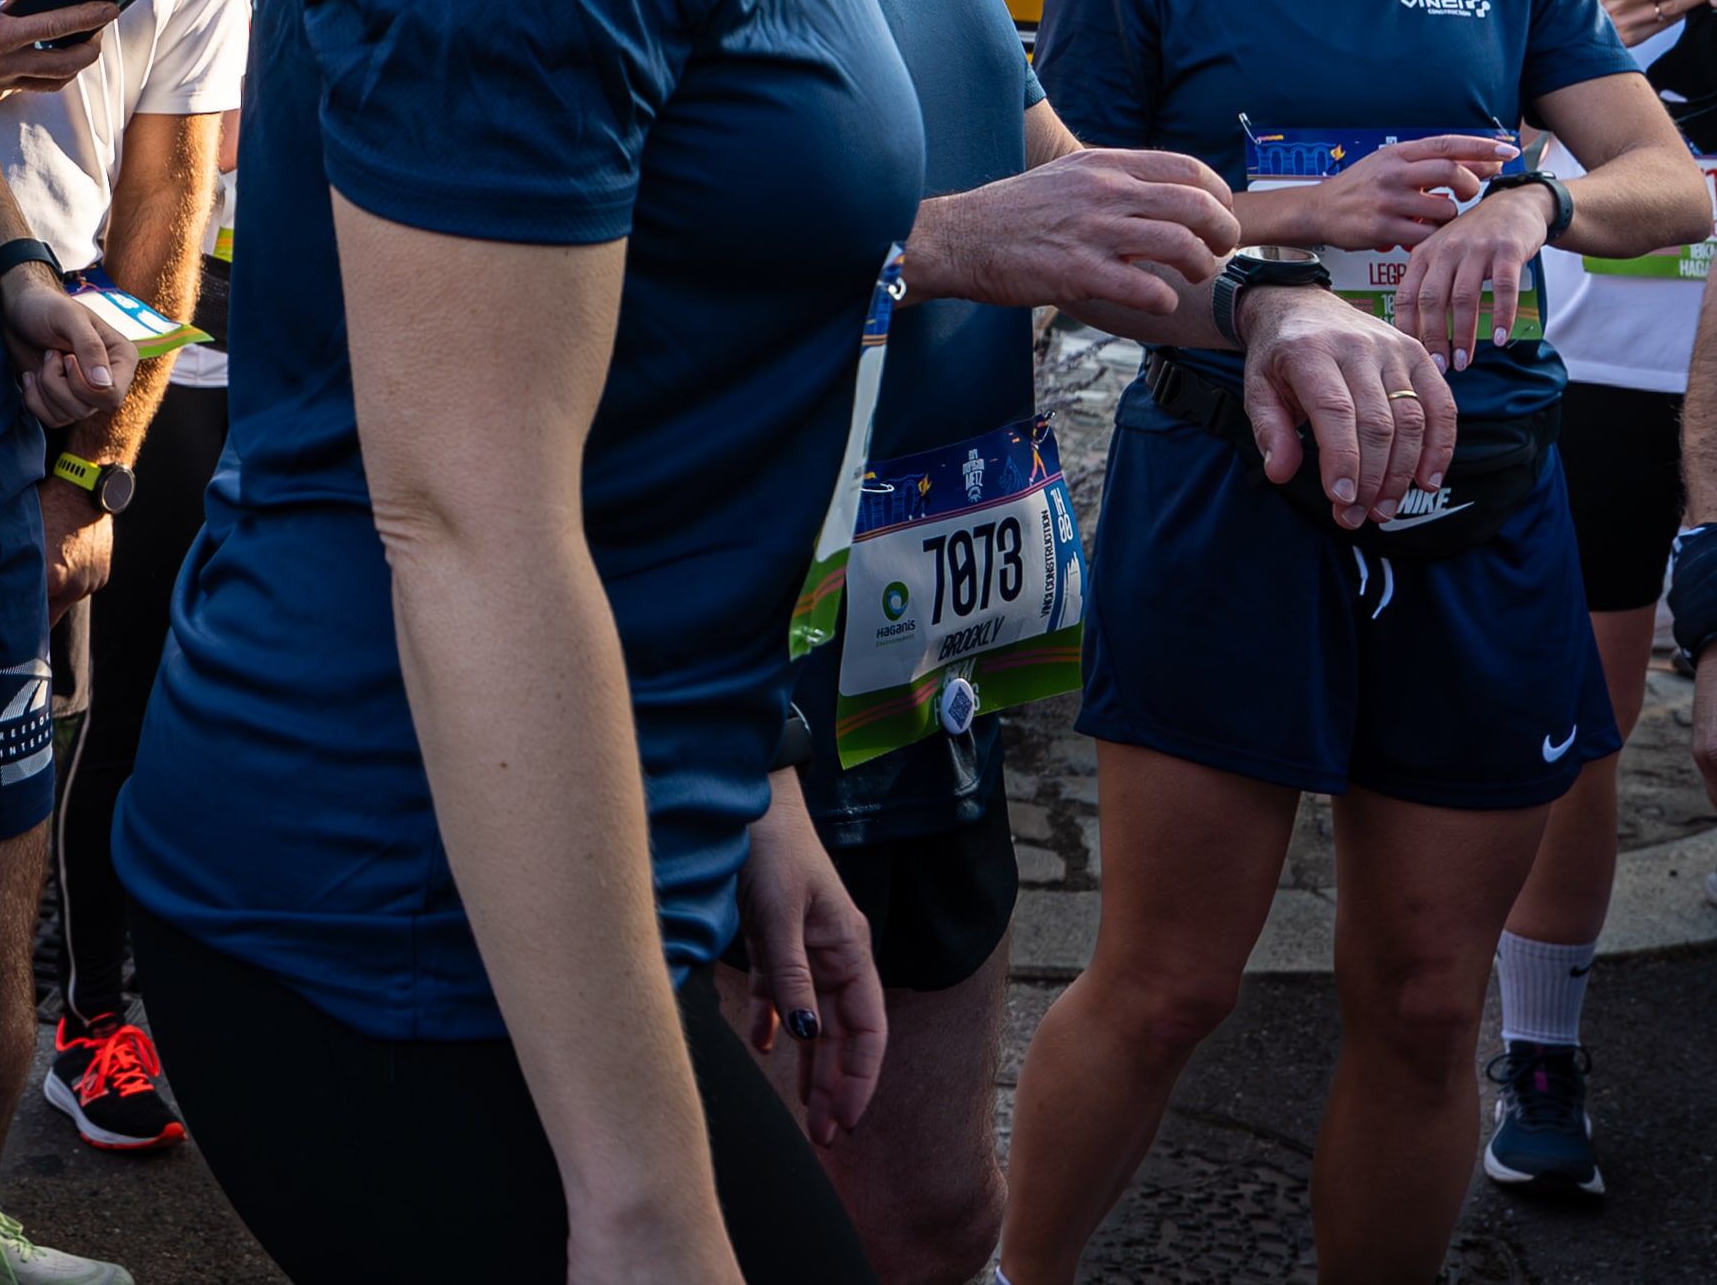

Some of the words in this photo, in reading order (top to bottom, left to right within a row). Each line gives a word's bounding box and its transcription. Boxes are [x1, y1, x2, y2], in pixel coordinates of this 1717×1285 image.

[1397, 487, 1452, 514] NIKE
[922, 516, 1024, 626] 7073
[1041, 509, 1055, 592] CONSTRUCTION
[1041, 594, 1054, 619] VINCI
